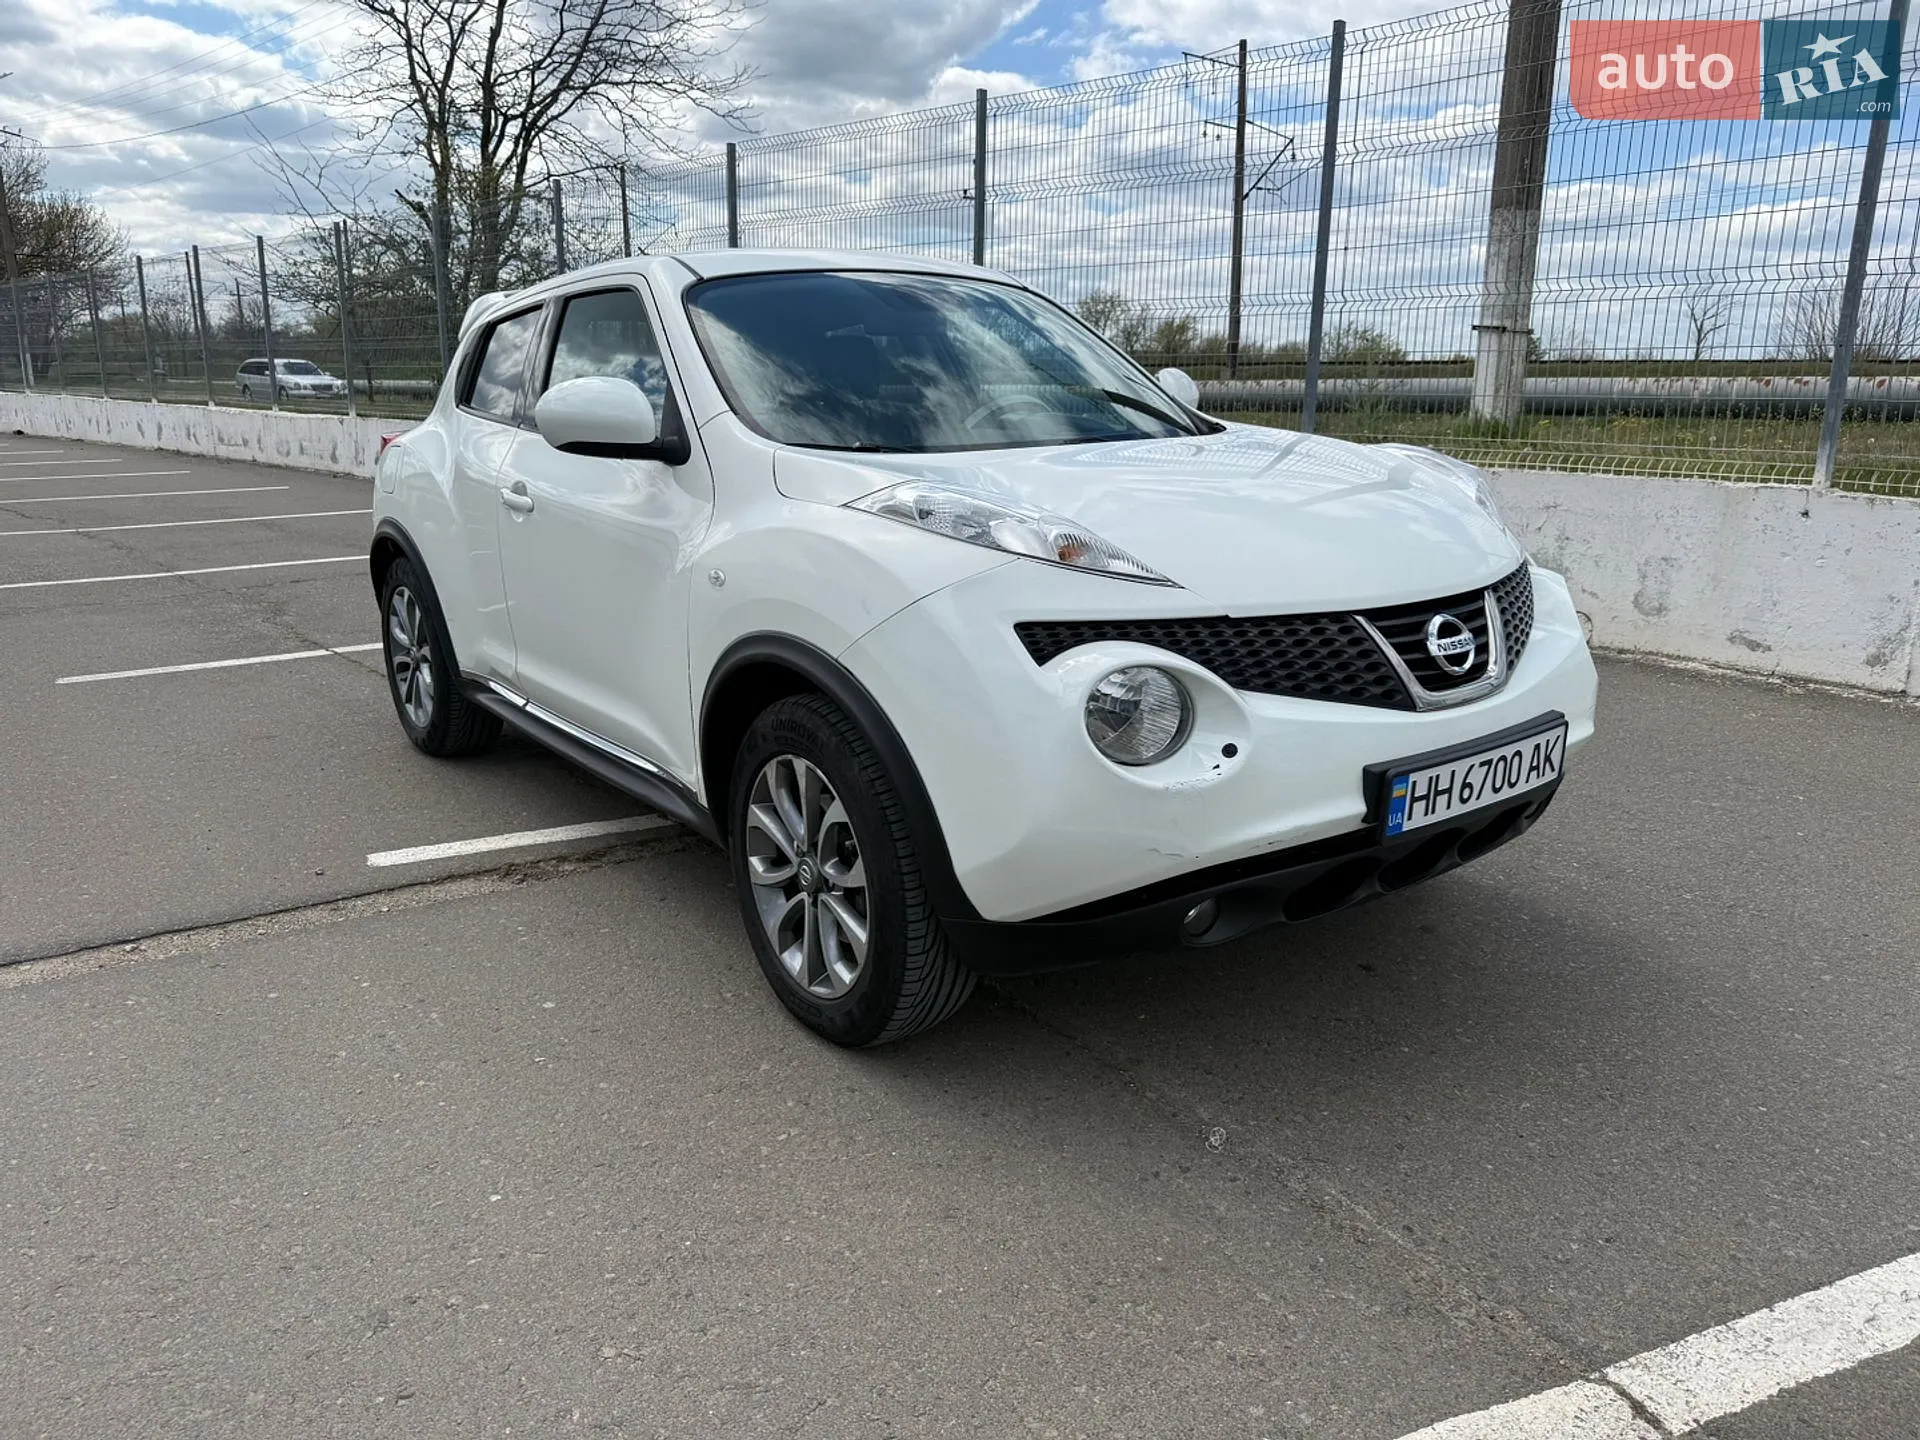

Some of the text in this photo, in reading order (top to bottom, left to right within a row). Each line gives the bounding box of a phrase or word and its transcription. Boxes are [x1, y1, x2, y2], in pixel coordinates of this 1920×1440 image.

[1437, 637, 1475, 653] NISSAN
[1406, 734, 1561, 821] HH 6700 AK
[1387, 812, 1403, 827] UA
